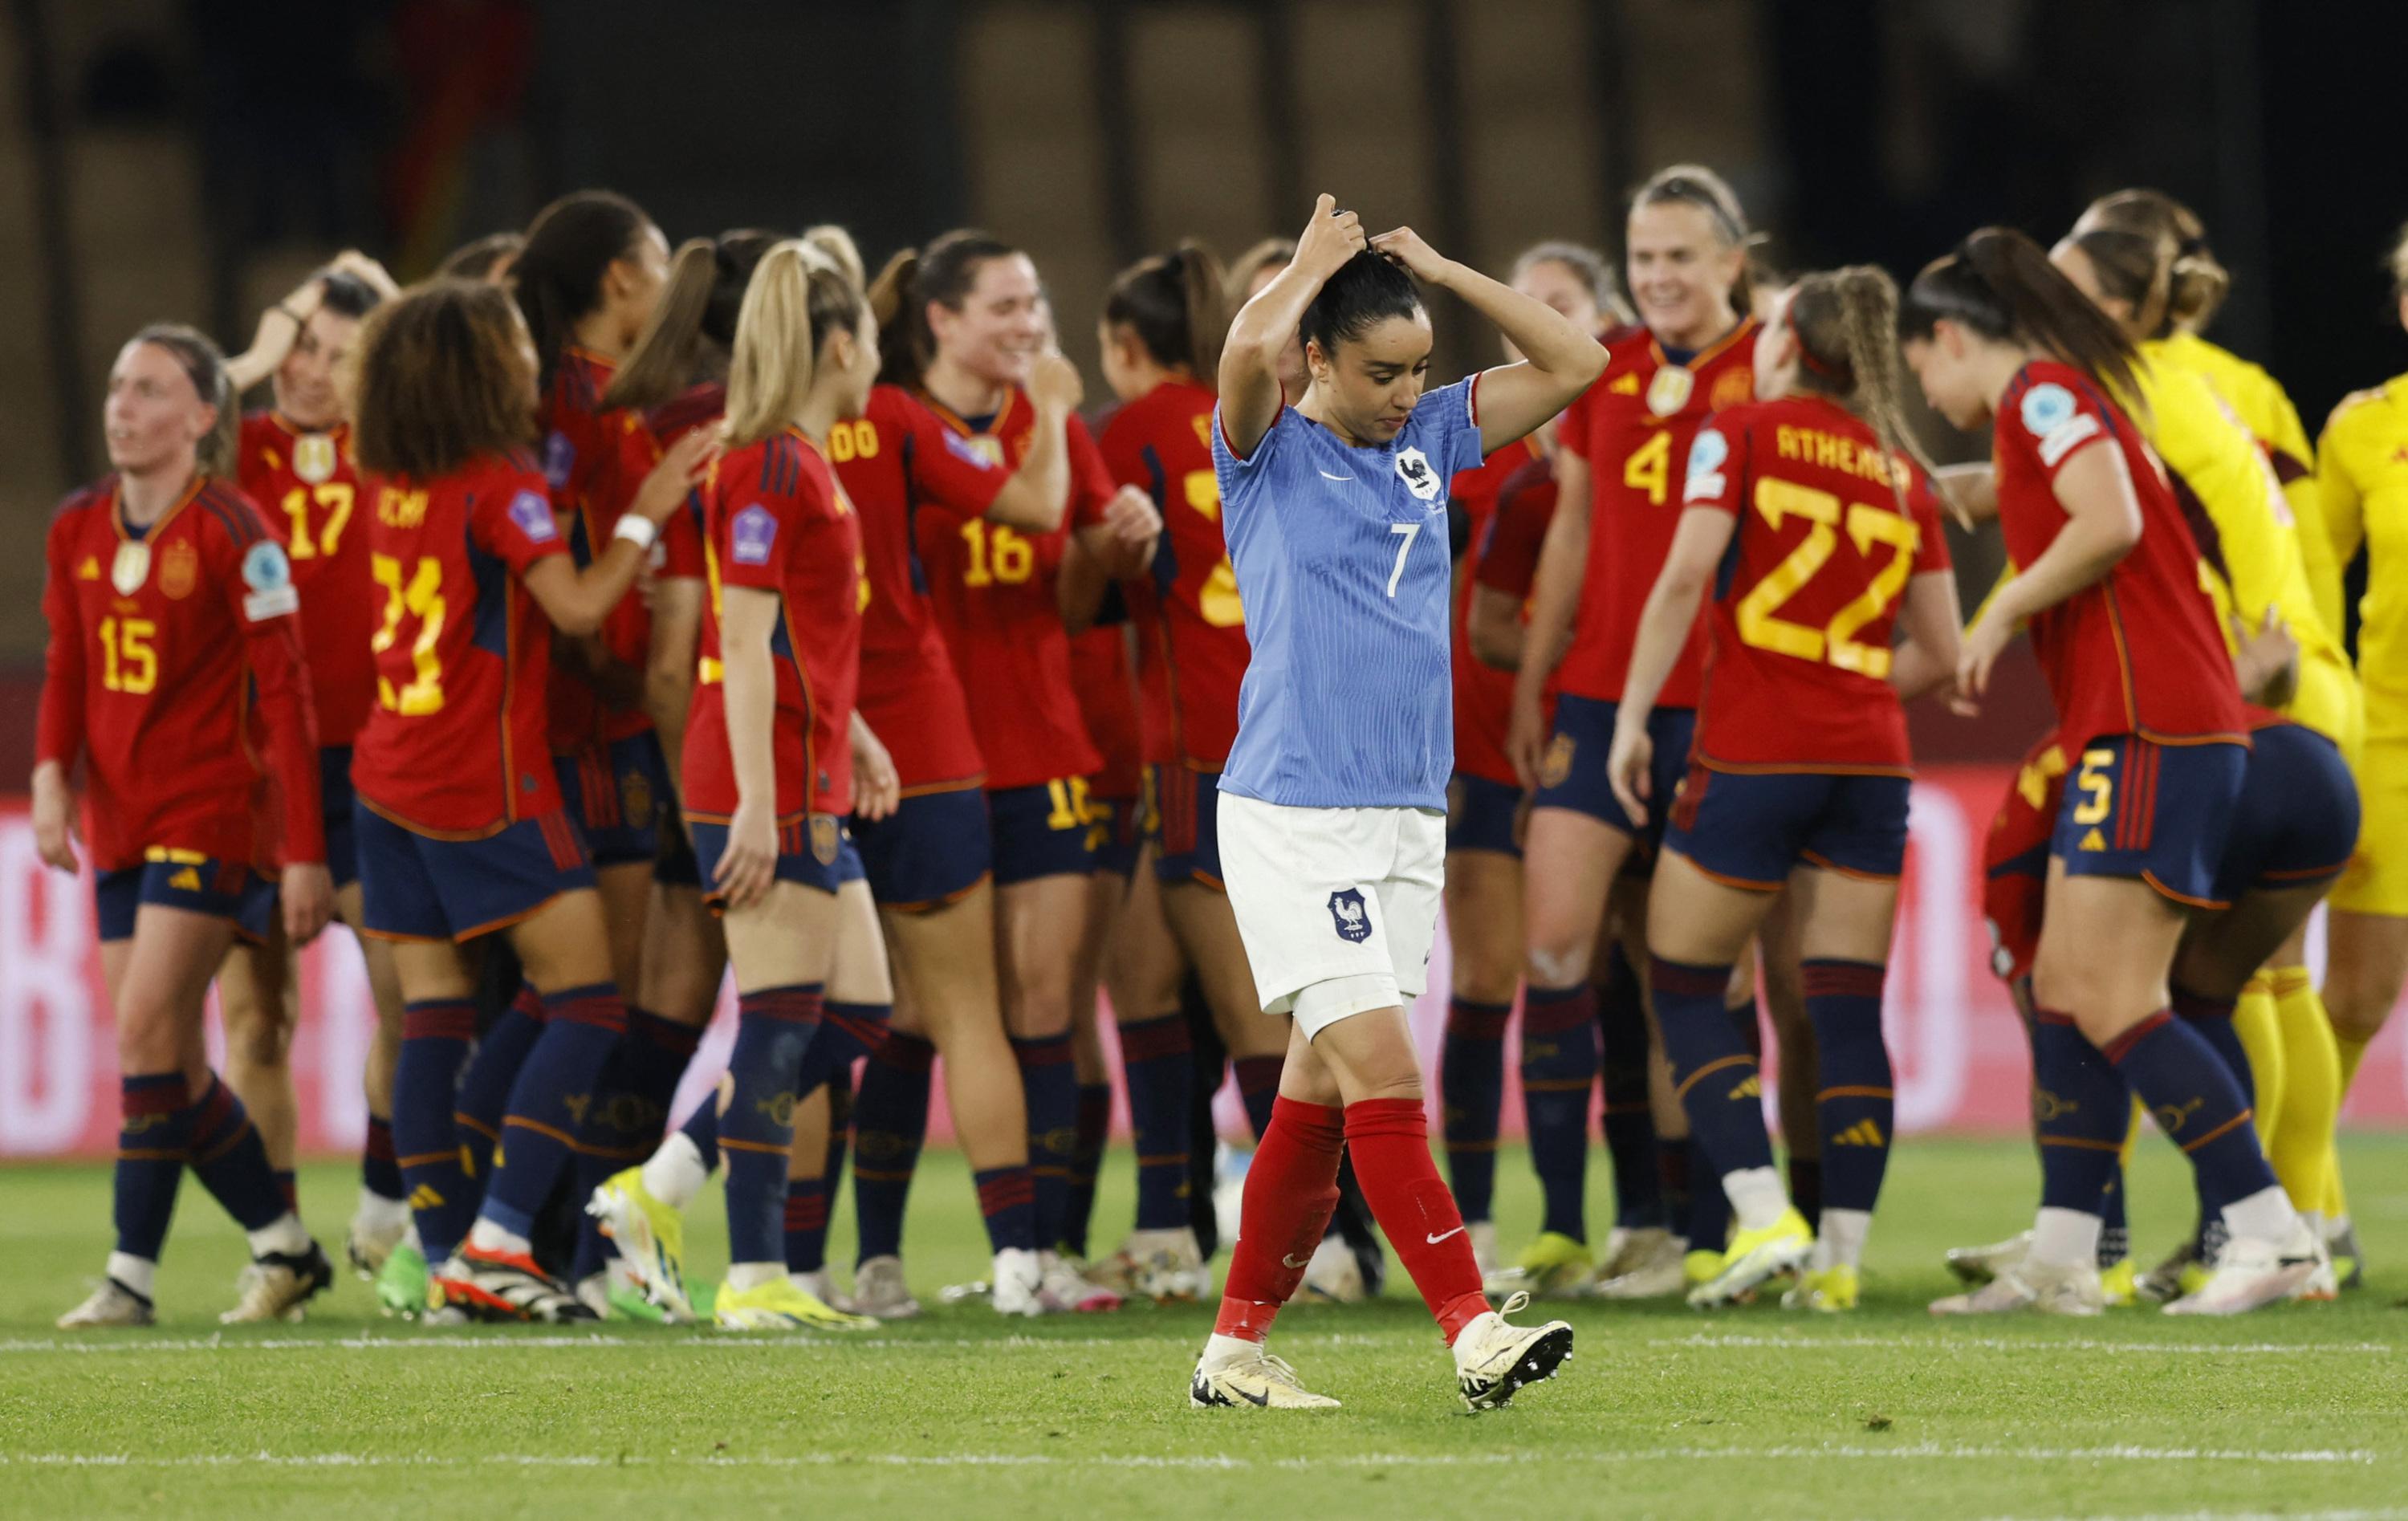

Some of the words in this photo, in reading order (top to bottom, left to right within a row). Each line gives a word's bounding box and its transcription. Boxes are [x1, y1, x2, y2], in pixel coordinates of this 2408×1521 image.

[1624, 429, 1673, 507] 4
[282, 483, 355, 560] 17
[962, 517, 1034, 587] 16
[1387, 523, 1421, 598] 7
[1735, 476, 1921, 681] 22
[98, 615, 158, 695] 15
[2073, 748, 2115, 826] 5
